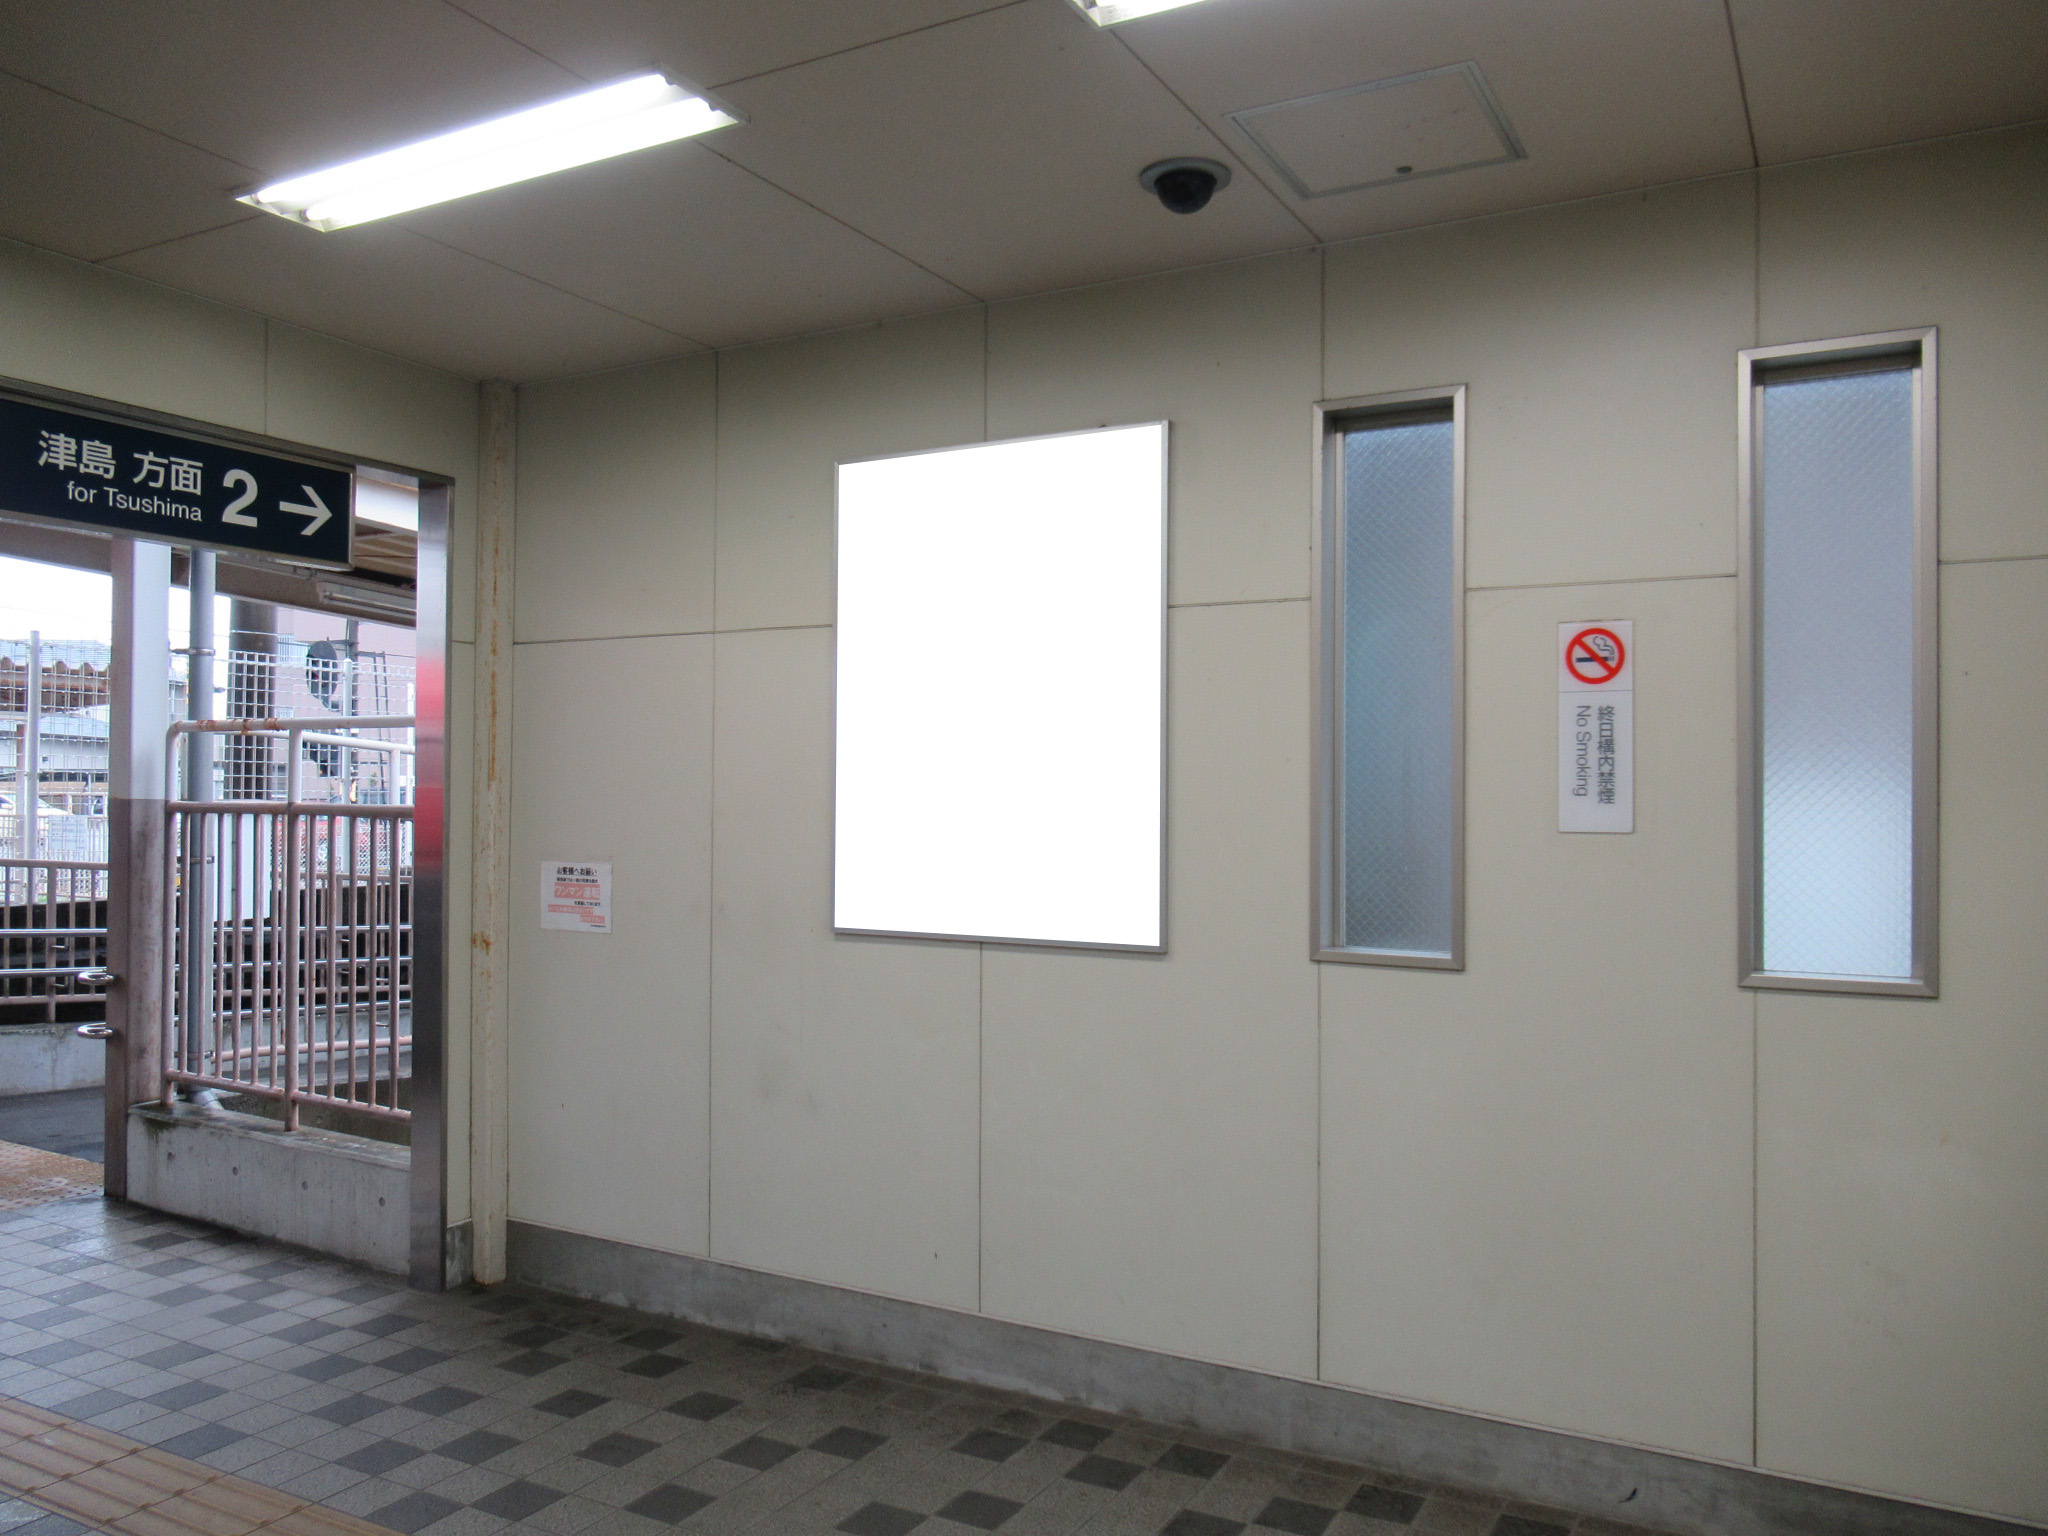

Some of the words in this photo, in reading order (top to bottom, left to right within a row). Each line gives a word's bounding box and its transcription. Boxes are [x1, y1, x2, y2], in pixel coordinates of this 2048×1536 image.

[37, 429, 117, 480] 津島
[132, 451, 204, 496] 方面
[67, 480, 97, 503] for
[103, 485, 203, 522] Tsushima
[221, 468, 259, 528] 2
[1576, 705, 1592, 727] No
[1573, 732, 1592, 798] Smoking
[1597, 705, 1615, 804] 終日構内禁煙
